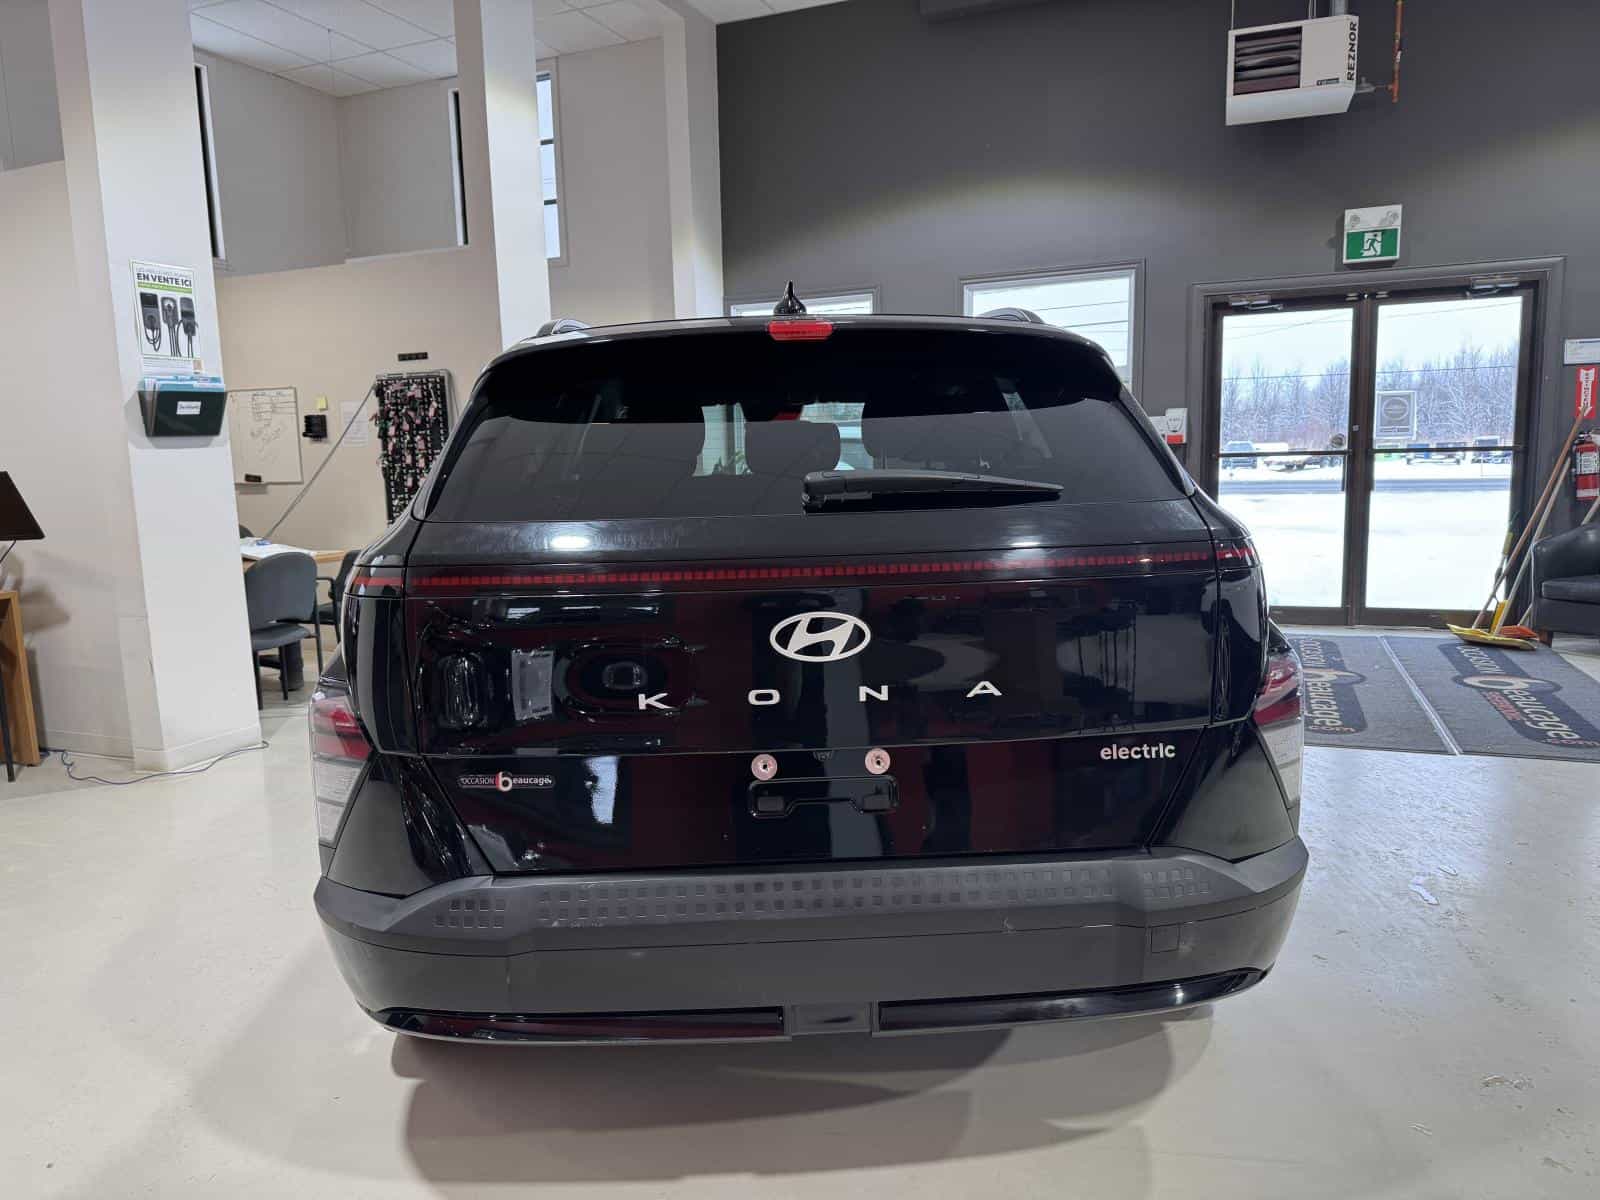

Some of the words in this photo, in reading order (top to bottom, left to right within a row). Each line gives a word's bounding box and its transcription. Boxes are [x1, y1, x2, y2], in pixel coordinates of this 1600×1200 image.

[1346, 21, 1357, 81] REZNOR
[136, 272, 149, 281] EN
[150, 274, 180, 285] VENTE
[181, 279, 192, 287] ICI
[1455, 645, 1507, 674] OCCASION
[638, 681, 1002, 709] KONA
[1463, 675, 1580, 739] beaucage
[1100, 743, 1176, 760] electric
[460, 777, 494, 785] OCCASION
